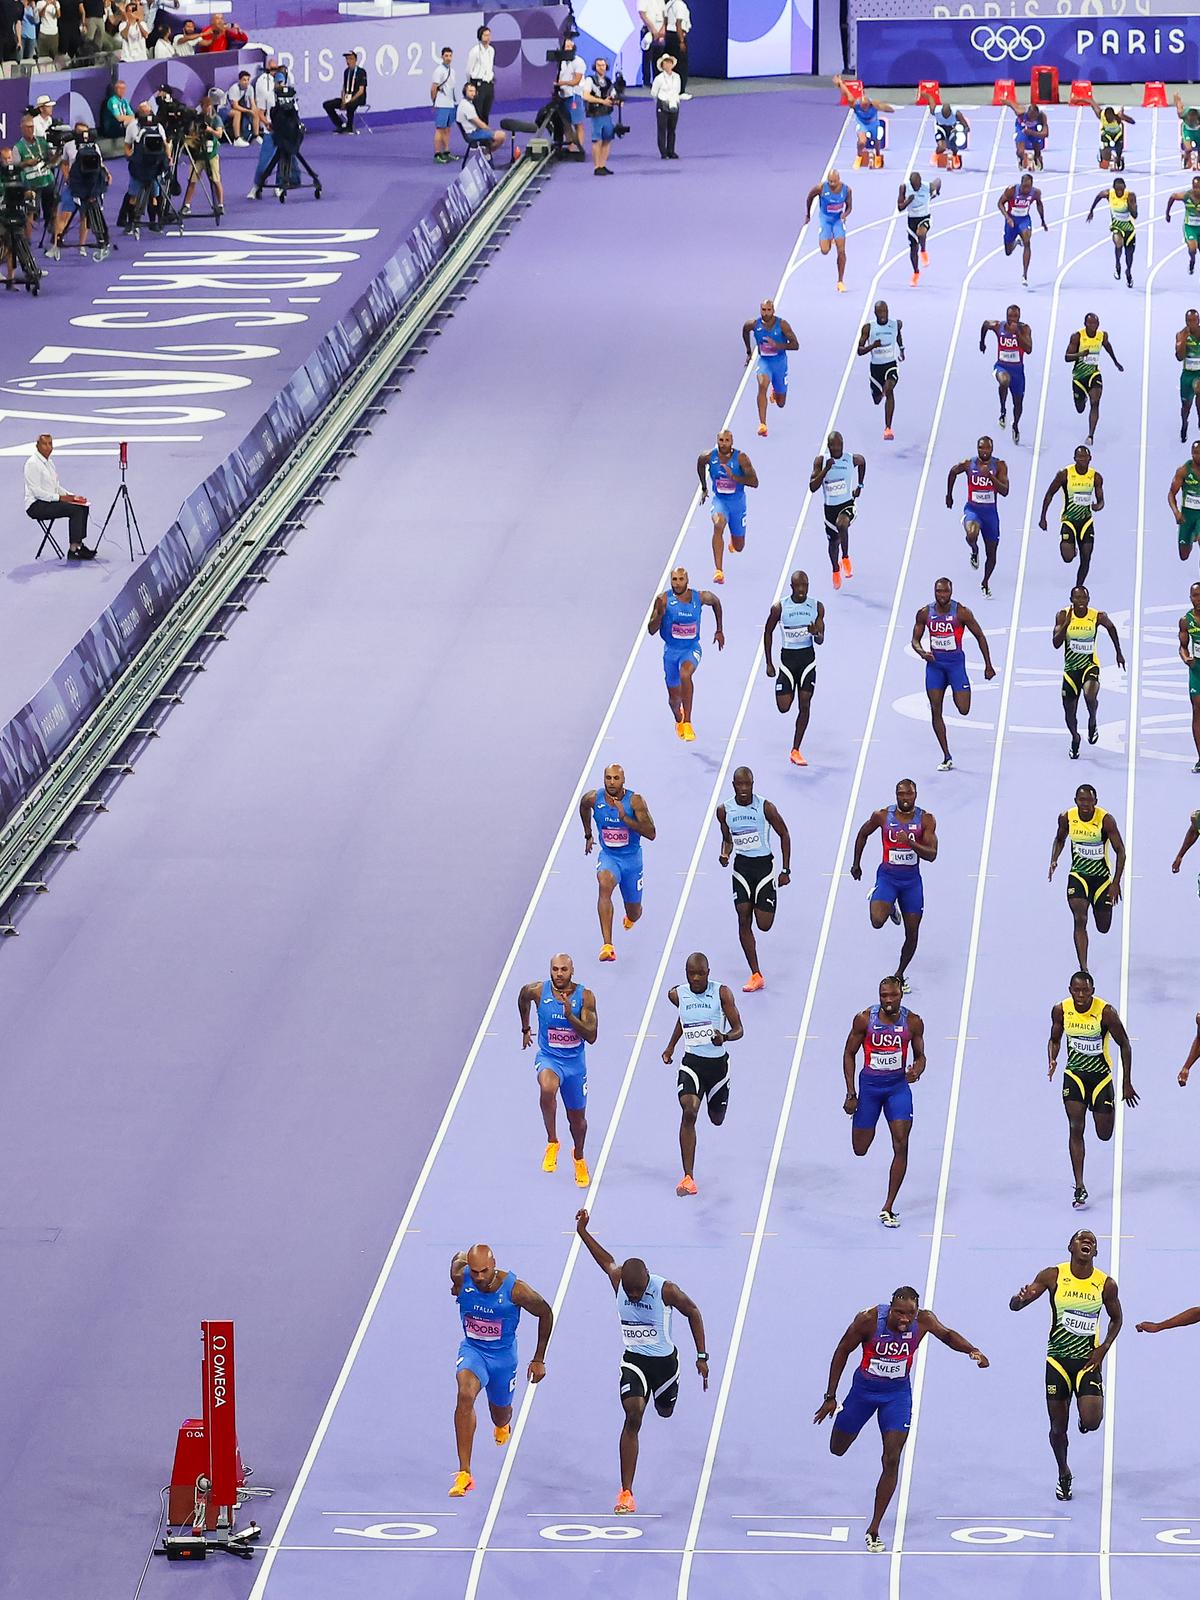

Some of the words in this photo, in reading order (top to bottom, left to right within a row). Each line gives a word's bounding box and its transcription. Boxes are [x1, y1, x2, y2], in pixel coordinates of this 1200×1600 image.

[1000, 336, 1018, 347] USA
[972, 474, 993, 486] USA
[930, 621, 954, 633] USA
[889, 829, 916, 842] UA
[1067, 1022, 1095, 1031] JAMAICA
[871, 1033, 902, 1047] USA
[1062, 1290, 1097, 1301] JAMAICA
[473, 1304, 494, 1314] ITALIA
[1064, 1317, 1096, 1331] SEVILLE
[875, 1341, 910, 1356] USA
[213, 1354, 227, 1409] OMEGA
[333, 1522, 438, 1540] 9
[539, 1524, 643, 1542] 8
[746, 1526, 849, 1542] 7
[950, 1526, 1055, 1545] 6
